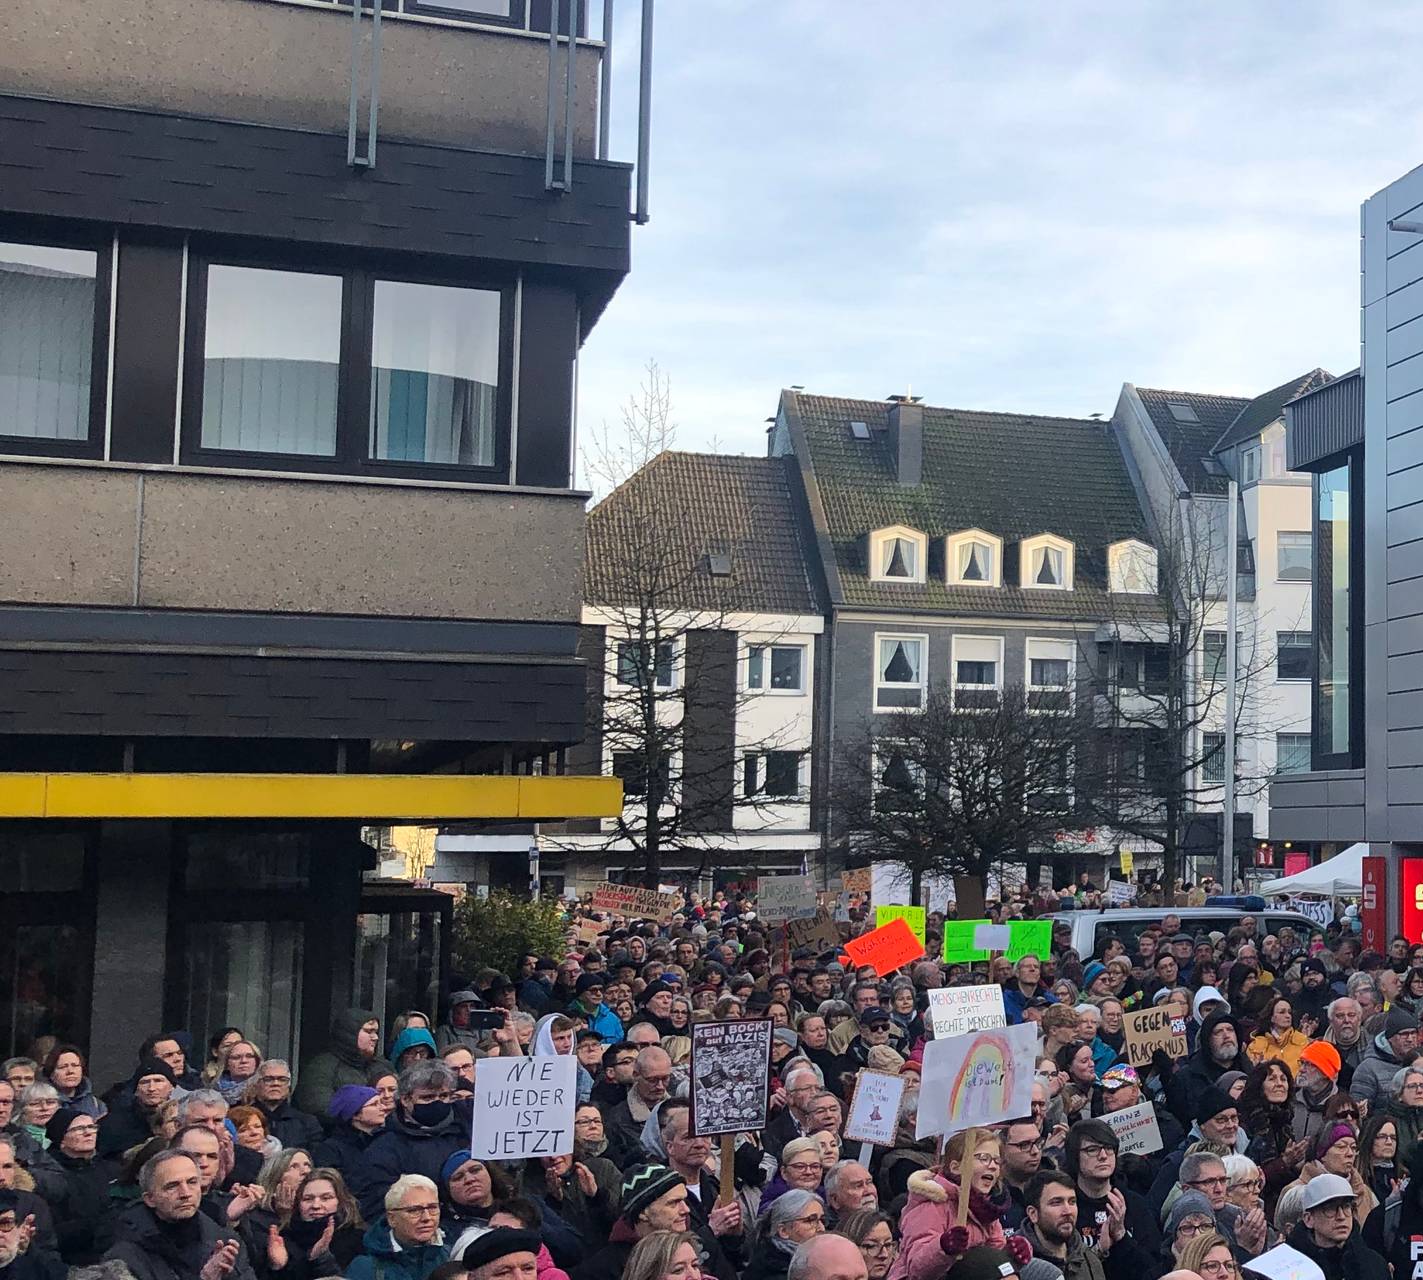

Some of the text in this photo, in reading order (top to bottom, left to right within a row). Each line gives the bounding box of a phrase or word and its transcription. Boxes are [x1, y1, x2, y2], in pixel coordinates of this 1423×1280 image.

[930, 987, 1000, 1006] MENSCHENRECHTE
[957, 1005, 980, 1016] STATT
[694, 1021, 765, 1038] KEIN BOCK
[934, 1018, 965, 1033] RECHTE
[1133, 1010, 1172, 1033] GEGEN
[706, 1031, 767, 1045] auf NAZIS
[506, 1062, 554, 1082] NIE
[488, 1088, 564, 1108] WIEDER
[516, 1110, 545, 1127] IST
[1104, 1110, 1142, 1126] ERANZ
[487, 1130, 565, 1155] JETZT
[1120, 1132, 1136, 1142] EIT
